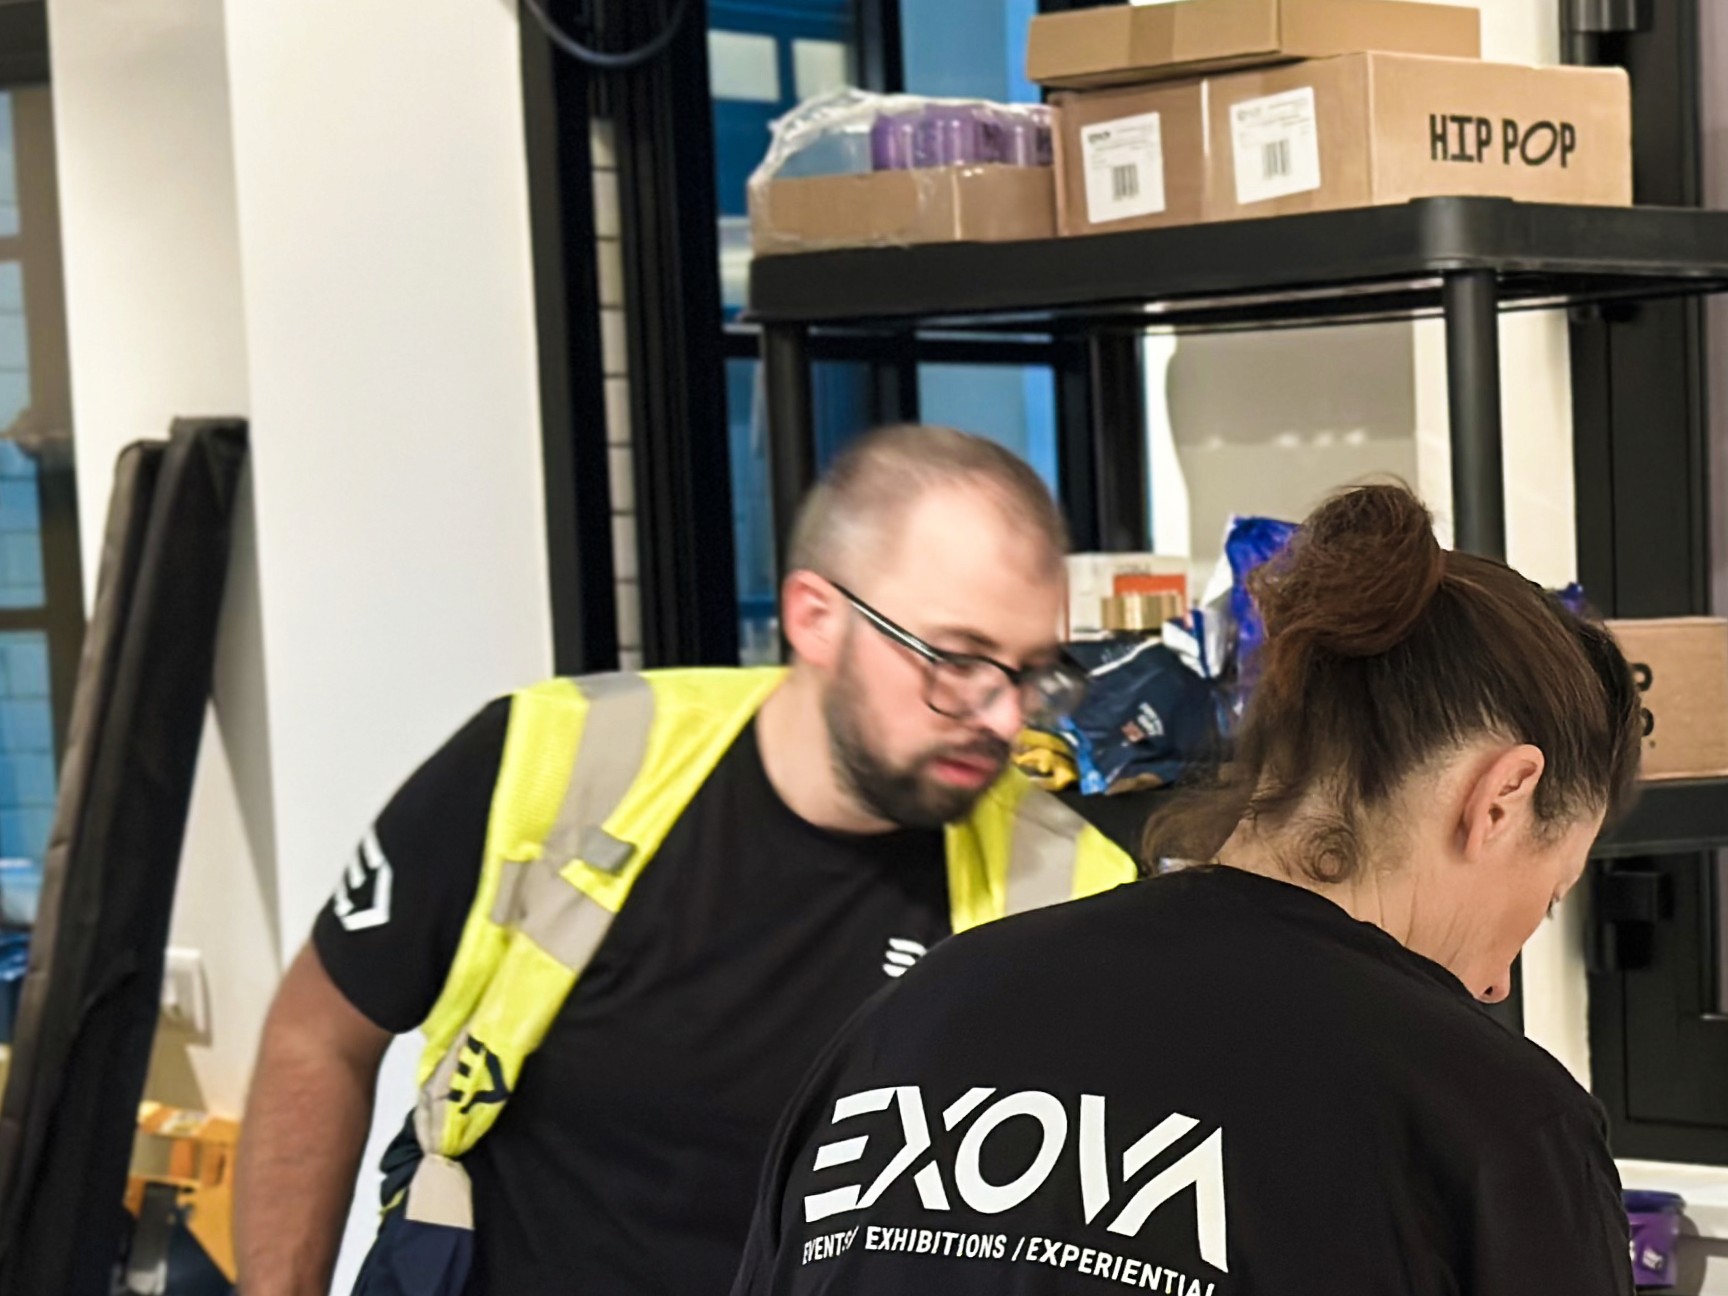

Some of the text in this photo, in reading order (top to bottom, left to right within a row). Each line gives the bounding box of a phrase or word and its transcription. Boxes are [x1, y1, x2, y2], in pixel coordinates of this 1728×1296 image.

[1429, 113, 1576, 168] HIP POP
[803, 1085, 1229, 1274] EXOVA
[864, 1225, 1007, 1259] EXHIBITIONS
